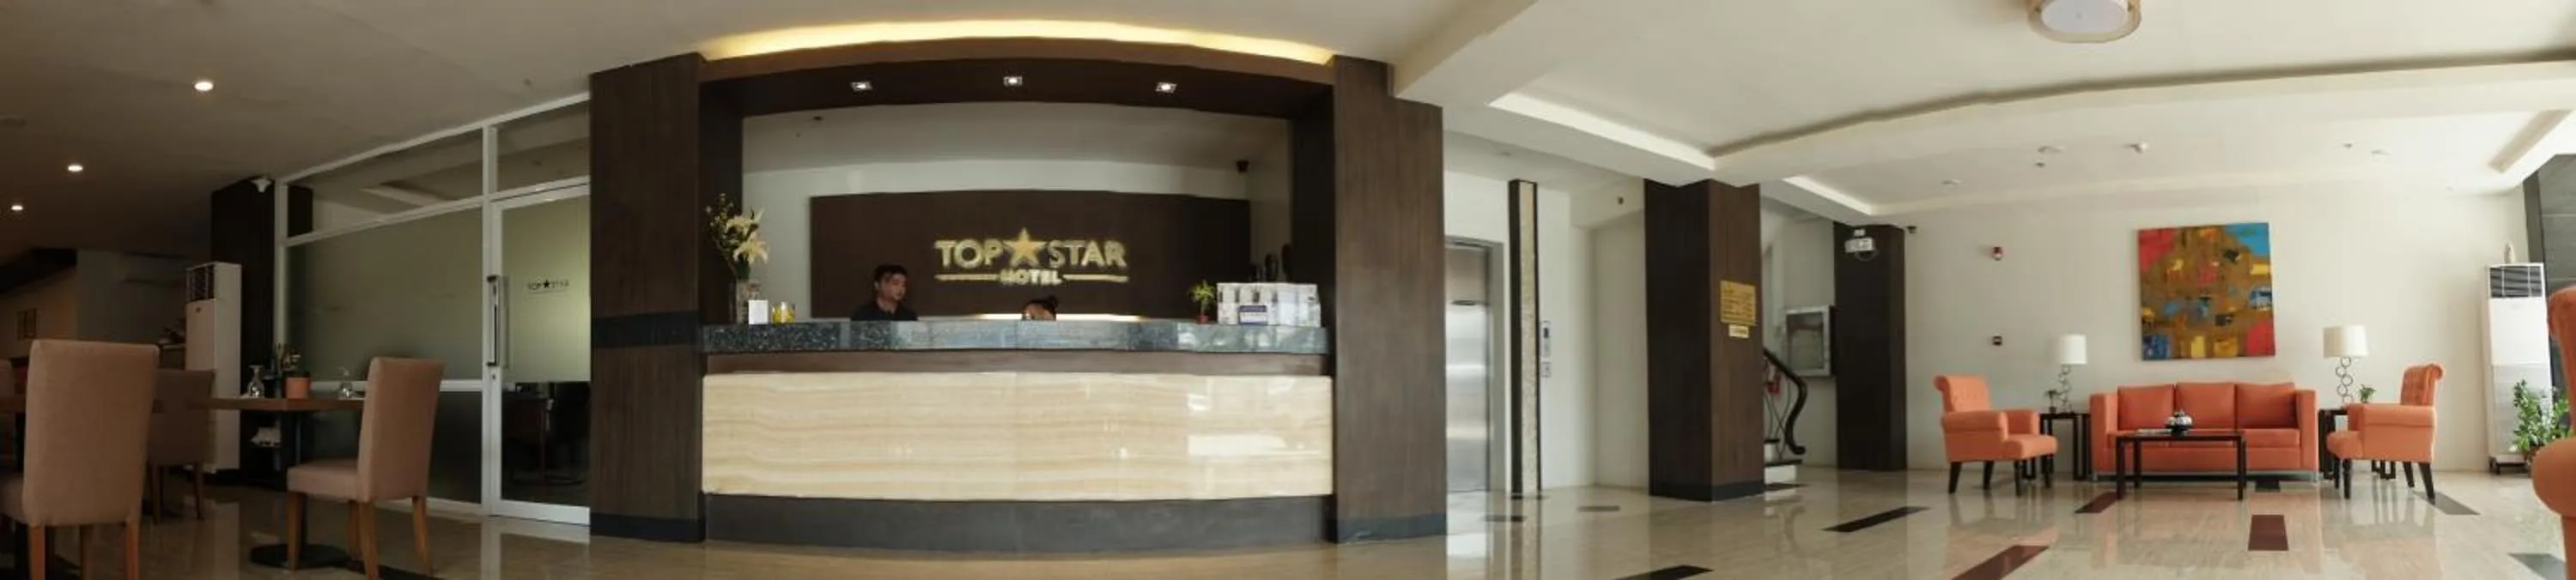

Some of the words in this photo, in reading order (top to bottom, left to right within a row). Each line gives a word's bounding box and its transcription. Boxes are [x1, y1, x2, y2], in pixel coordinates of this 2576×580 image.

[934, 239, 1004, 269] TOP
[1047, 240, 1127, 267] STAR
[999, 269, 1062, 285] HOTEL
